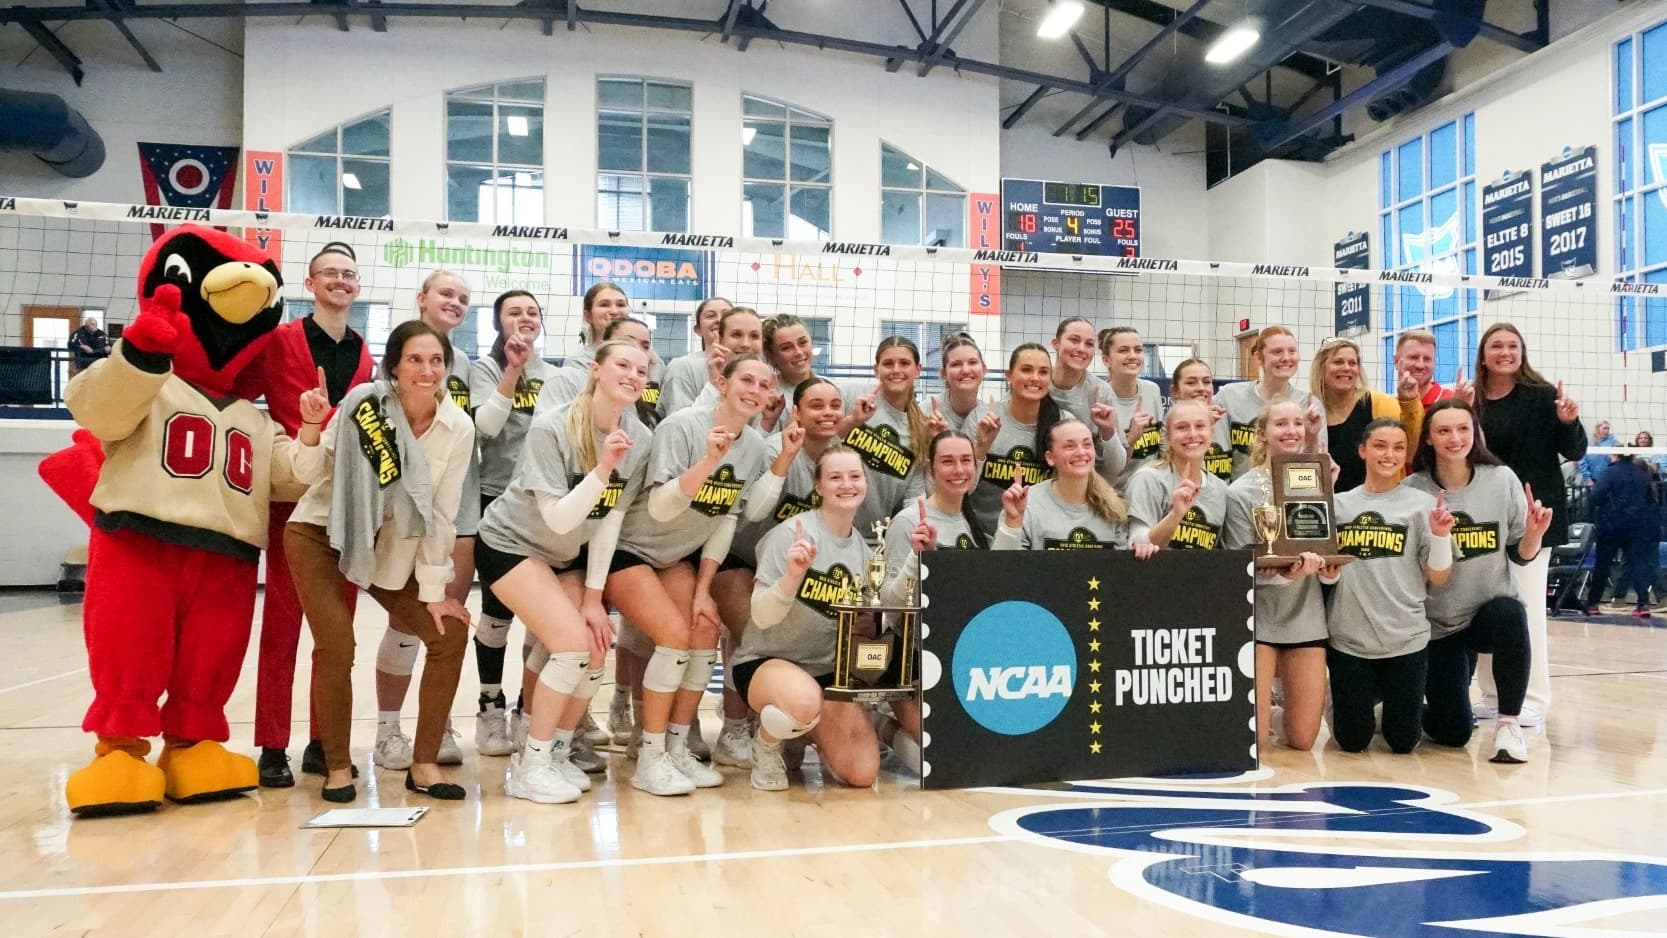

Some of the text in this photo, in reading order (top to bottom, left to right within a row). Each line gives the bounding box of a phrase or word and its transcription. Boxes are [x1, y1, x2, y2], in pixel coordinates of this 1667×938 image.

[1543, 157, 1594, 184] MARIETTA
[1484, 180, 1530, 204] MARIETTA
[126, 205, 210, 222] MARIETTA
[1010, 202, 1039, 213] HOME
[1060, 209, 1085, 217] PERIOD
[1106, 208, 1138, 218] GUEST
[1545, 206, 1578, 230] SWEET
[1579, 202, 1592, 219] 16
[314, 215, 394, 232] MARIETTA
[492, 225, 568, 240] MARIETTA
[1020, 214, 1036, 233] 18
[1067, 217, 1078, 235] 4
[1113, 219, 1135, 238] 25
[661, 233, 733, 248] MARIETTA
[1005, 232, 1028, 240] FOULS
[1055, 235, 1081, 243] PLAYER
[1487, 223, 1529, 248] ELITE 8
[1550, 226, 1587, 256] 2017
[419, 239, 549, 273] Huntington
[822, 242, 891, 256] MARIETTA
[974, 249, 1039, 264] MARIETTA
[977, 201, 992, 307] WILY'S
[1117, 257, 1178, 271] MARIETTA
[1491, 246, 1524, 272] 2015
[588, 257, 698, 281] QDOBA
[1252, 265, 1309, 277] MARIETTA
[1379, 271, 1433, 283] MARIETTA
[486, 275, 549, 290] Welcome
[1498, 278, 1549, 289] MARIETTA
[1610, 284, 1659, 295] MARIETTA
[1341, 296, 1362, 316] 2011
[846, 427, 911, 476] CHAMPIONS
[694, 484, 738, 506] HAMPIO
[1172, 525, 1217, 550] AMPIONS
[1454, 531, 1496, 549] PIONS
[1131, 627, 1217, 666] TICKET
[966, 664, 1073, 702] NCAA
[1115, 666, 1233, 706] PUNCHED
